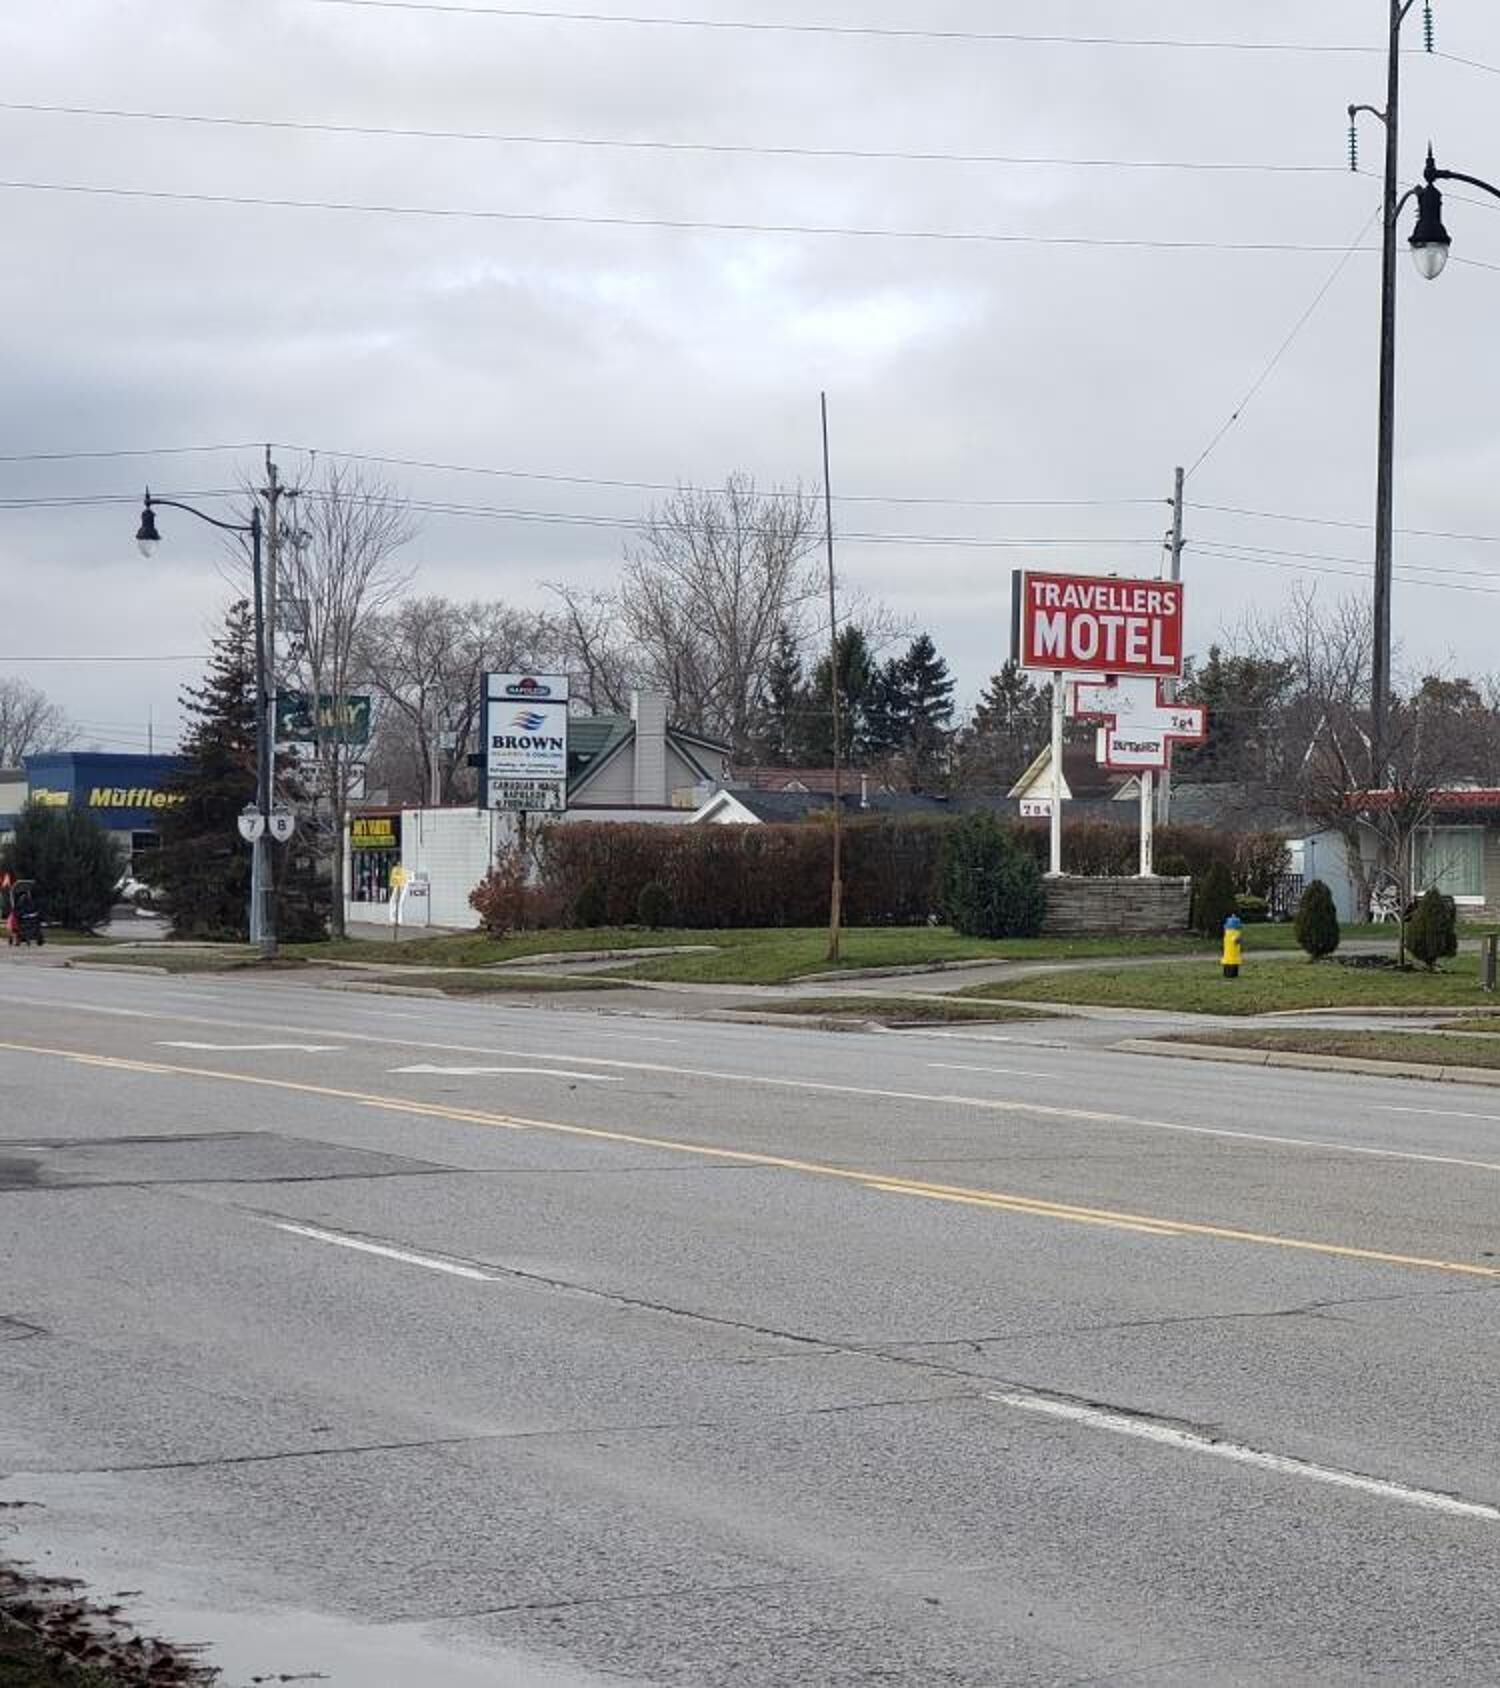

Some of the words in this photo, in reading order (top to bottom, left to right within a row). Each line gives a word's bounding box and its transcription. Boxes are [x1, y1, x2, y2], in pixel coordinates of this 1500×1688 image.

[1032, 582, 1176, 615] TRAVELLERS
[1033, 610, 1175, 665] MOTEL
[492, 735, 563, 750] BROWN
[247, 819, 255, 832] 7
[277, 819, 287, 831] 8
